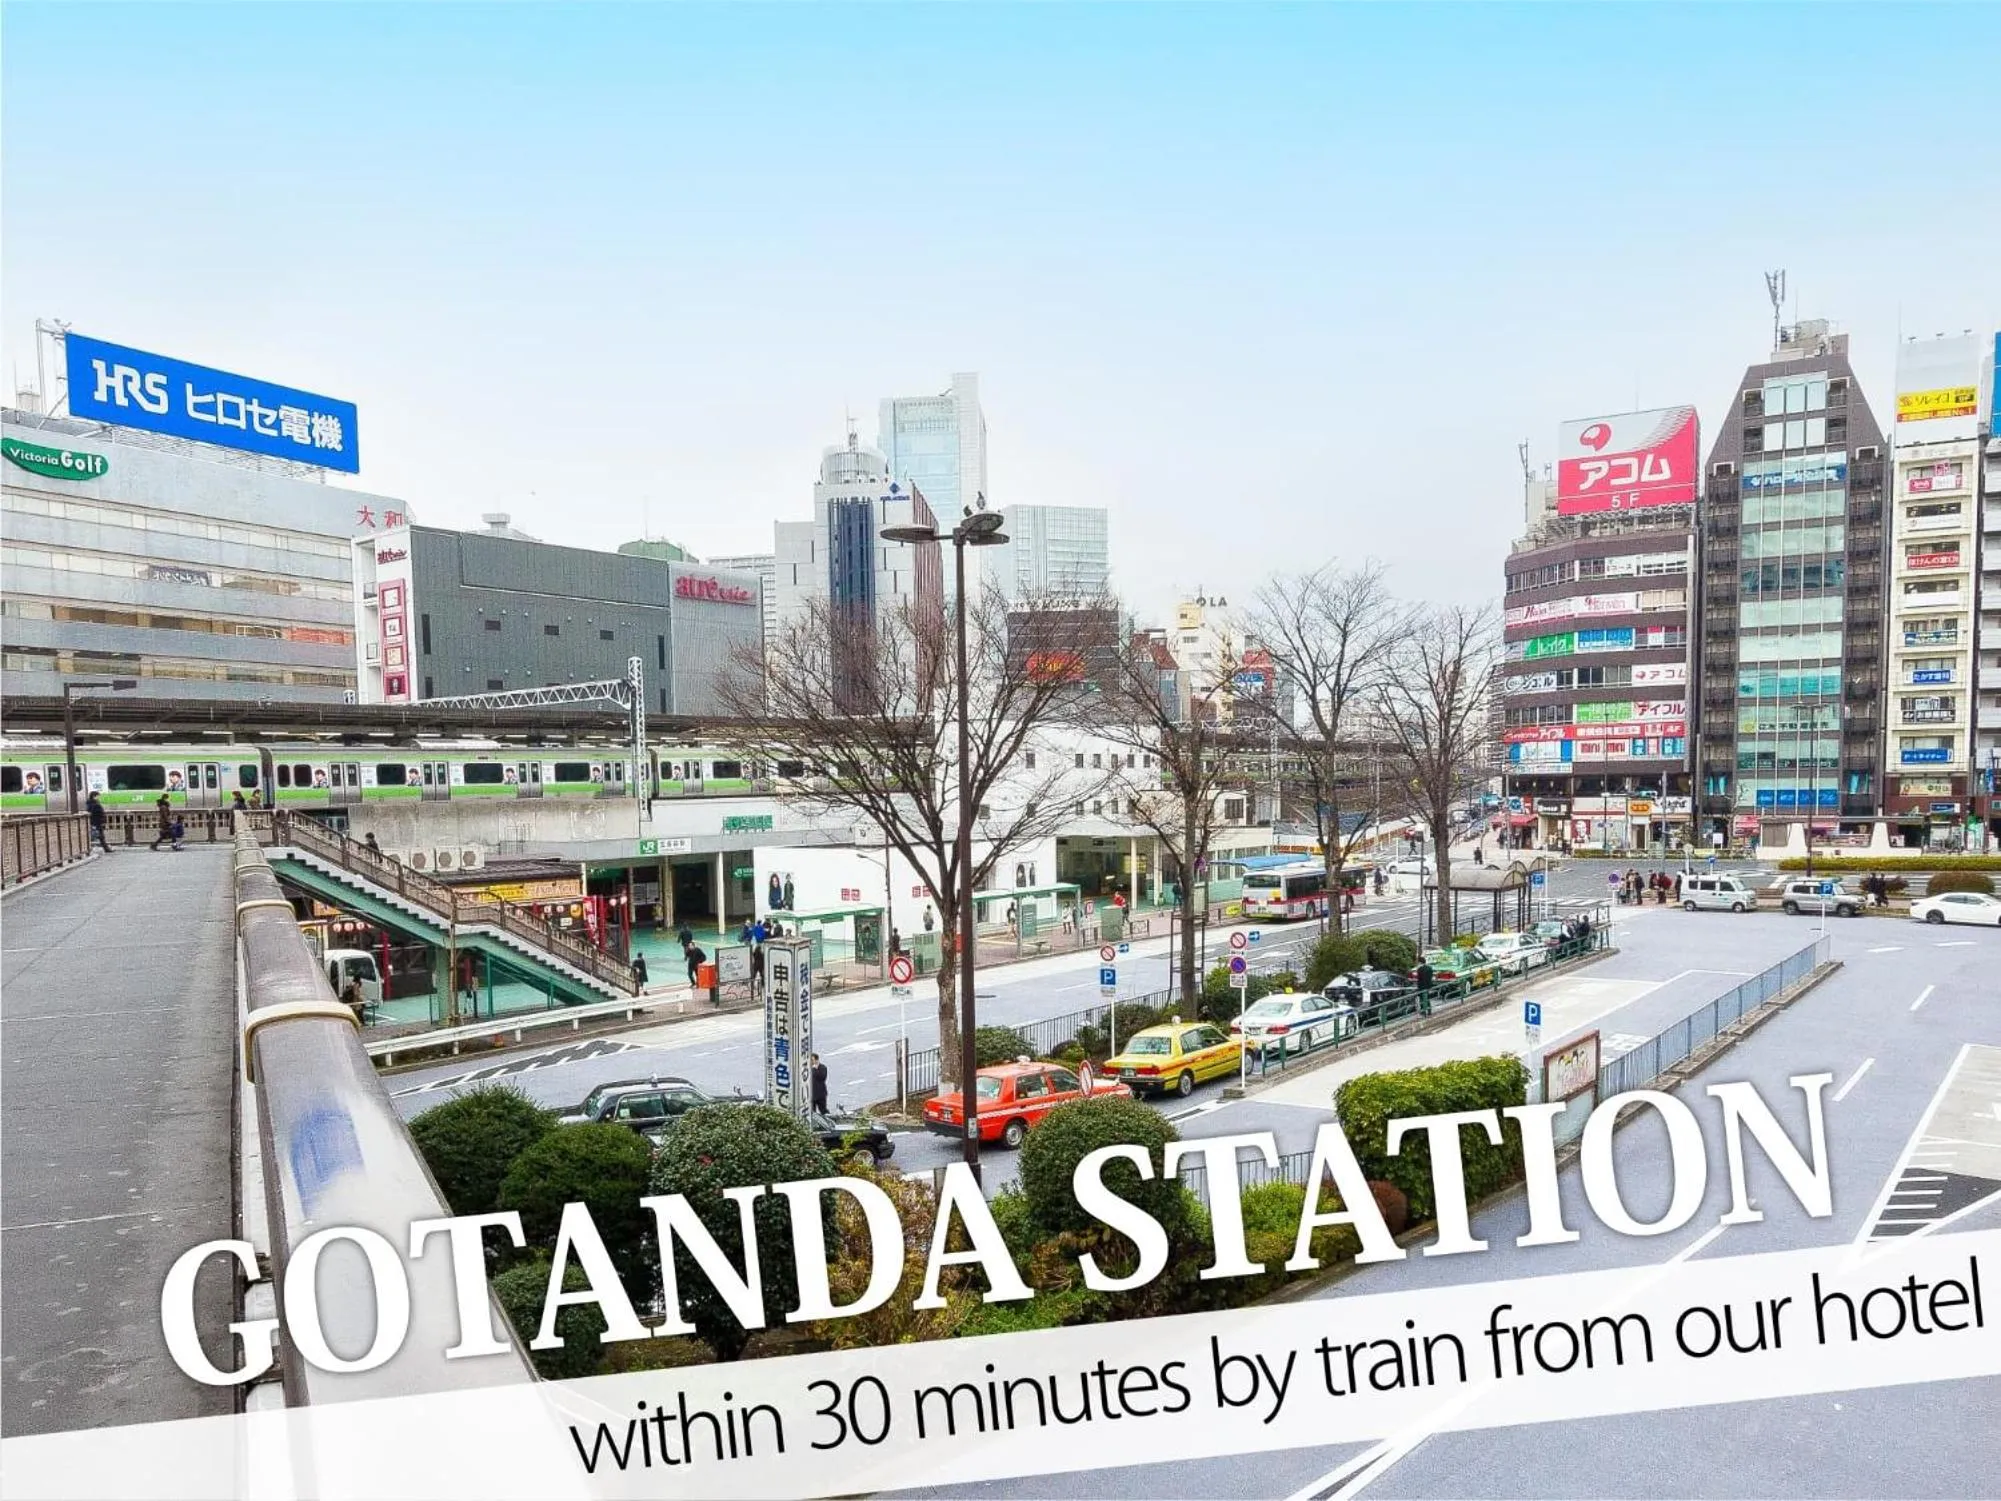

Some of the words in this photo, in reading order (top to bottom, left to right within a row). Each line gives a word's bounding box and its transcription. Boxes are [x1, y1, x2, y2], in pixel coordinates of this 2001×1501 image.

[91, 358, 170, 416] HRS
[184, 381, 343, 452] ヒロセ電機
[9, 446, 59, 467] Victoria
[60, 450, 103, 475] Golf
[1579, 453, 1672, 491] アコム
[642, 840, 655, 851] JR
[773, 961, 791, 1110] 申告は青色で
